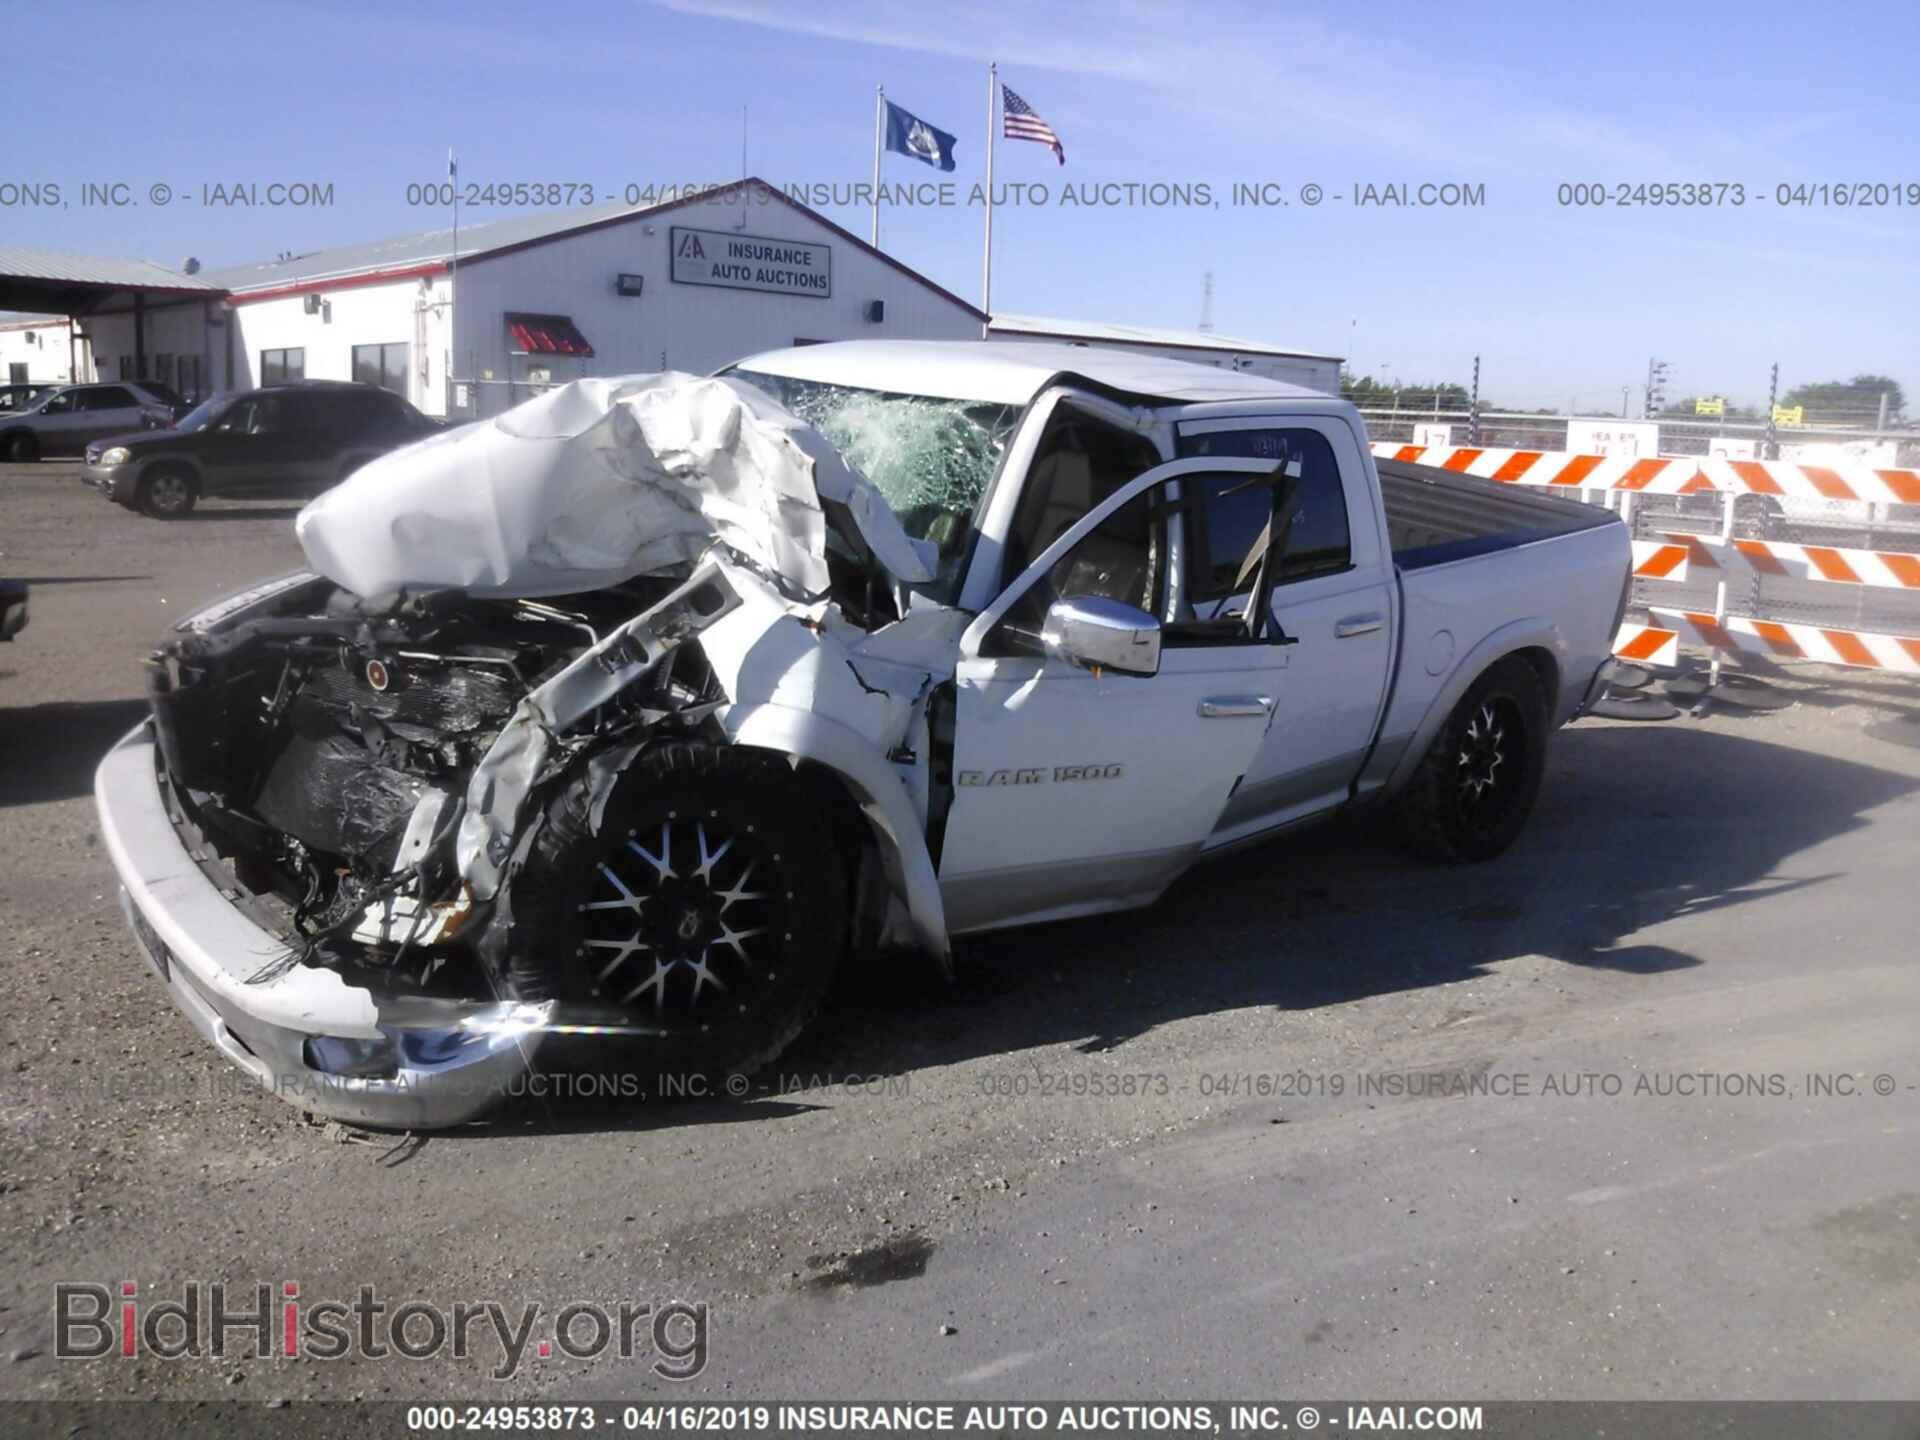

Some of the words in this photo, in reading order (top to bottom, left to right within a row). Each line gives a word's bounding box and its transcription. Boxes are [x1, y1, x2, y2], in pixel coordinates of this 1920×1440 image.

[728, 241, 812, 266] INSURANCE
[711, 263, 750, 281] AUTO
[755, 268, 828, 289] AUCTIONS
[958, 767, 1048, 787] RAM
[1053, 763, 1127, 783] 1500
